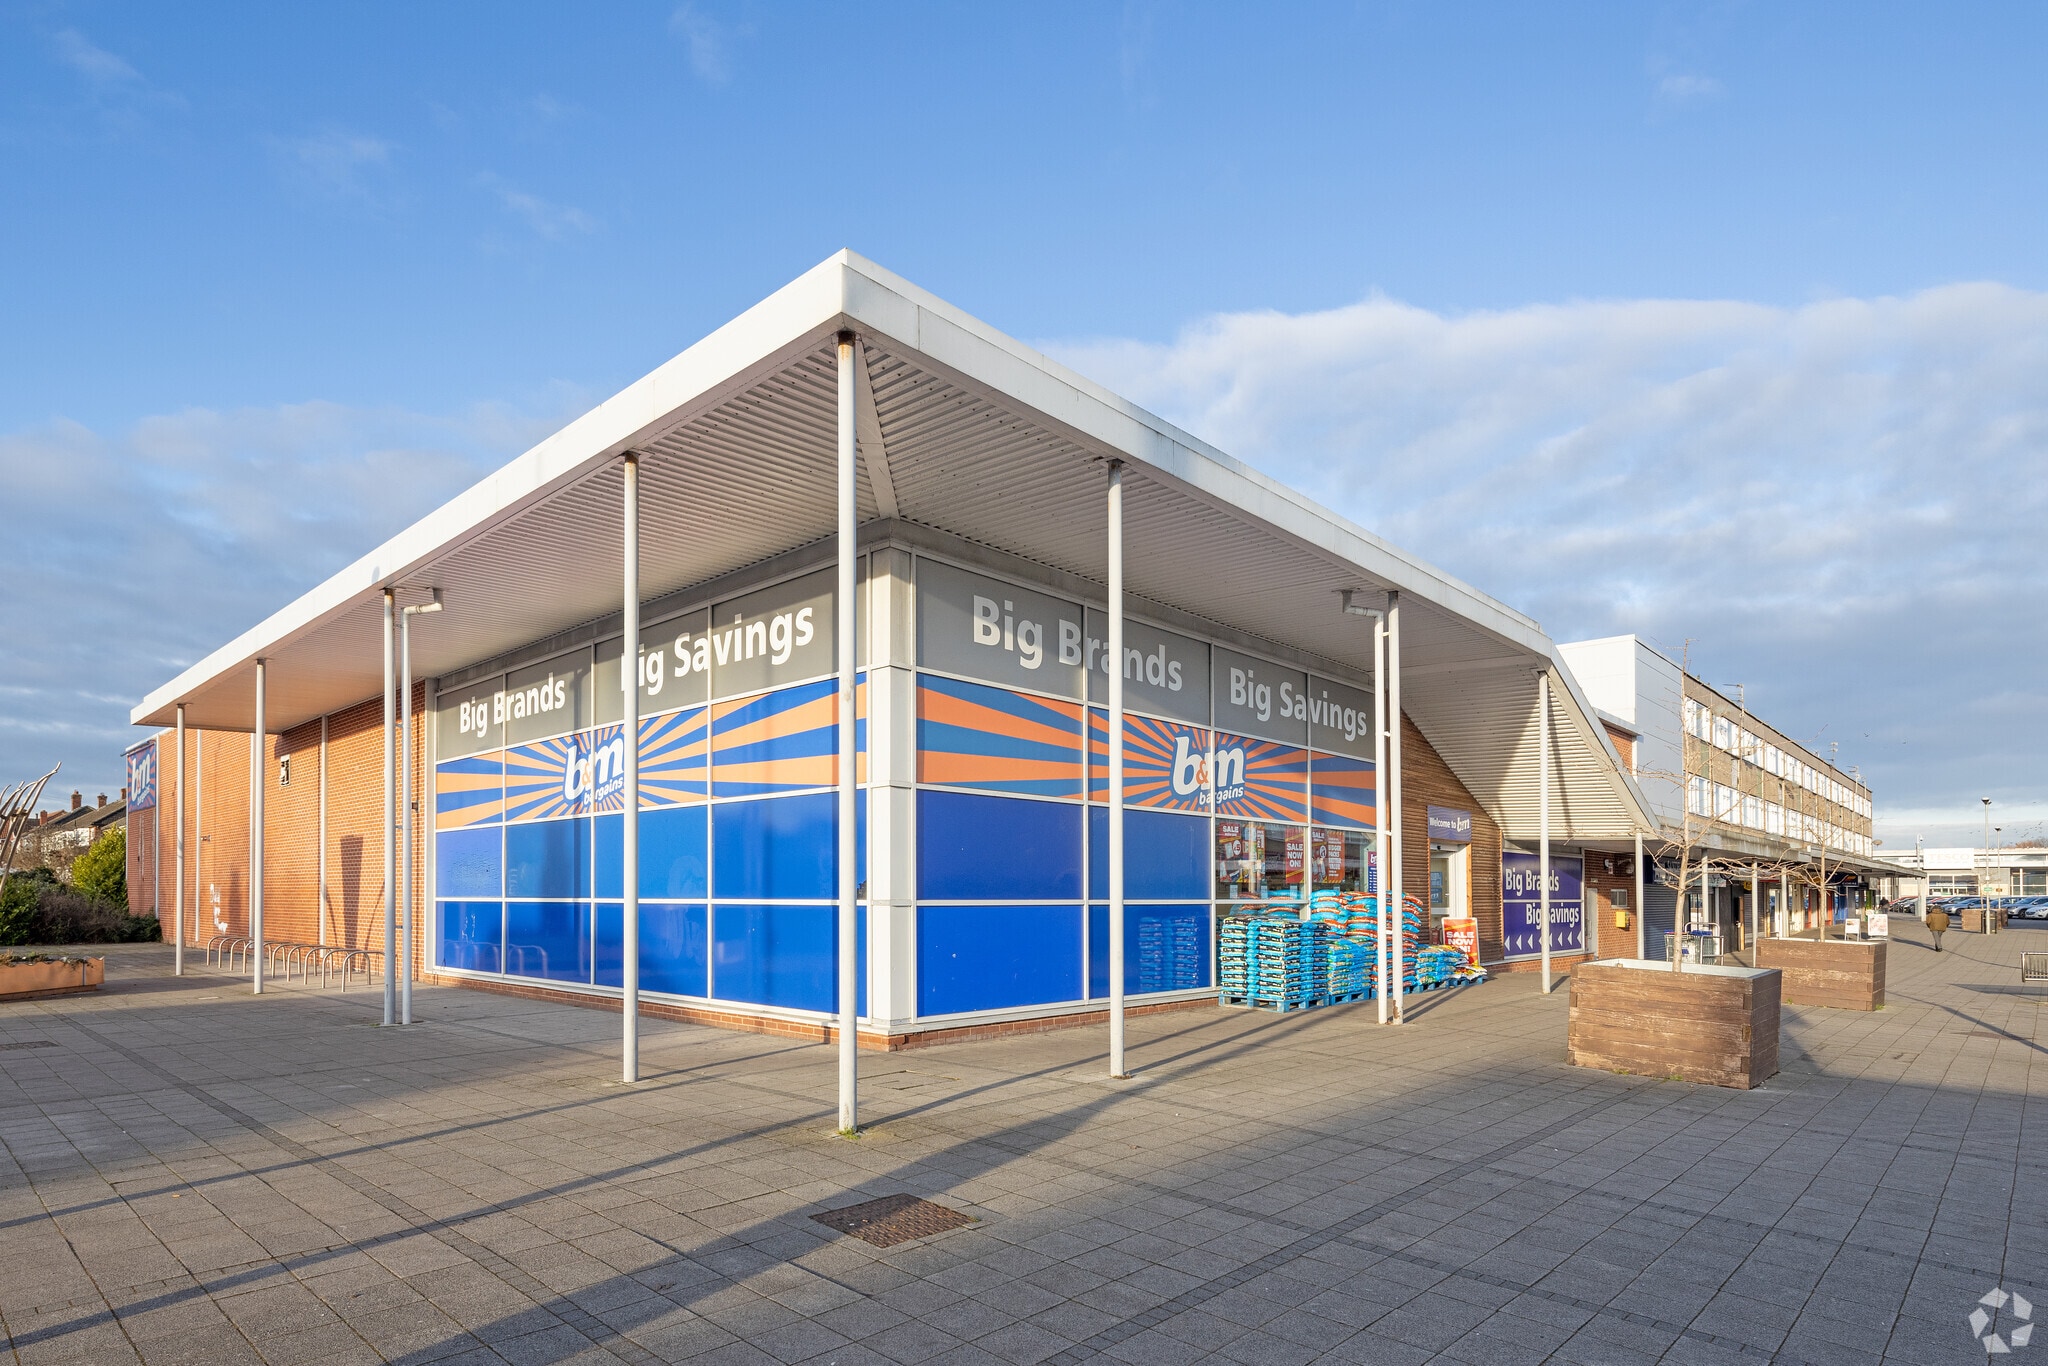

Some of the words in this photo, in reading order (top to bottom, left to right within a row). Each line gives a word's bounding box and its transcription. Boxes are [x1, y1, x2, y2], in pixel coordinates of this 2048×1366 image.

[973, 595, 1043, 670] Big
[621, 644, 664, 695] ig
[674, 607, 814, 677] Savings
[460, 696, 488, 738] Big
[494, 672, 566, 724] Brands
[1230, 667, 1271, 722] Big
[1279, 681, 1367, 742] Savings
[584, 777, 624, 805] brgains
[1199, 786, 1244, 805] bagains
[1222, 825, 1239, 833] SALE
[1312, 831, 1325, 839] SALE
[1286, 843, 1303, 851] SALE
[1289, 860, 1302, 868] ON!
[1505, 867, 1523, 897] Big
[1525, 869, 1560, 892] Brads
[1526, 902, 1542, 930] Big
[1549, 902, 1580, 928] avings
[1447, 938, 1474, 946] NOW
[1458, 945, 1471, 953] N!
